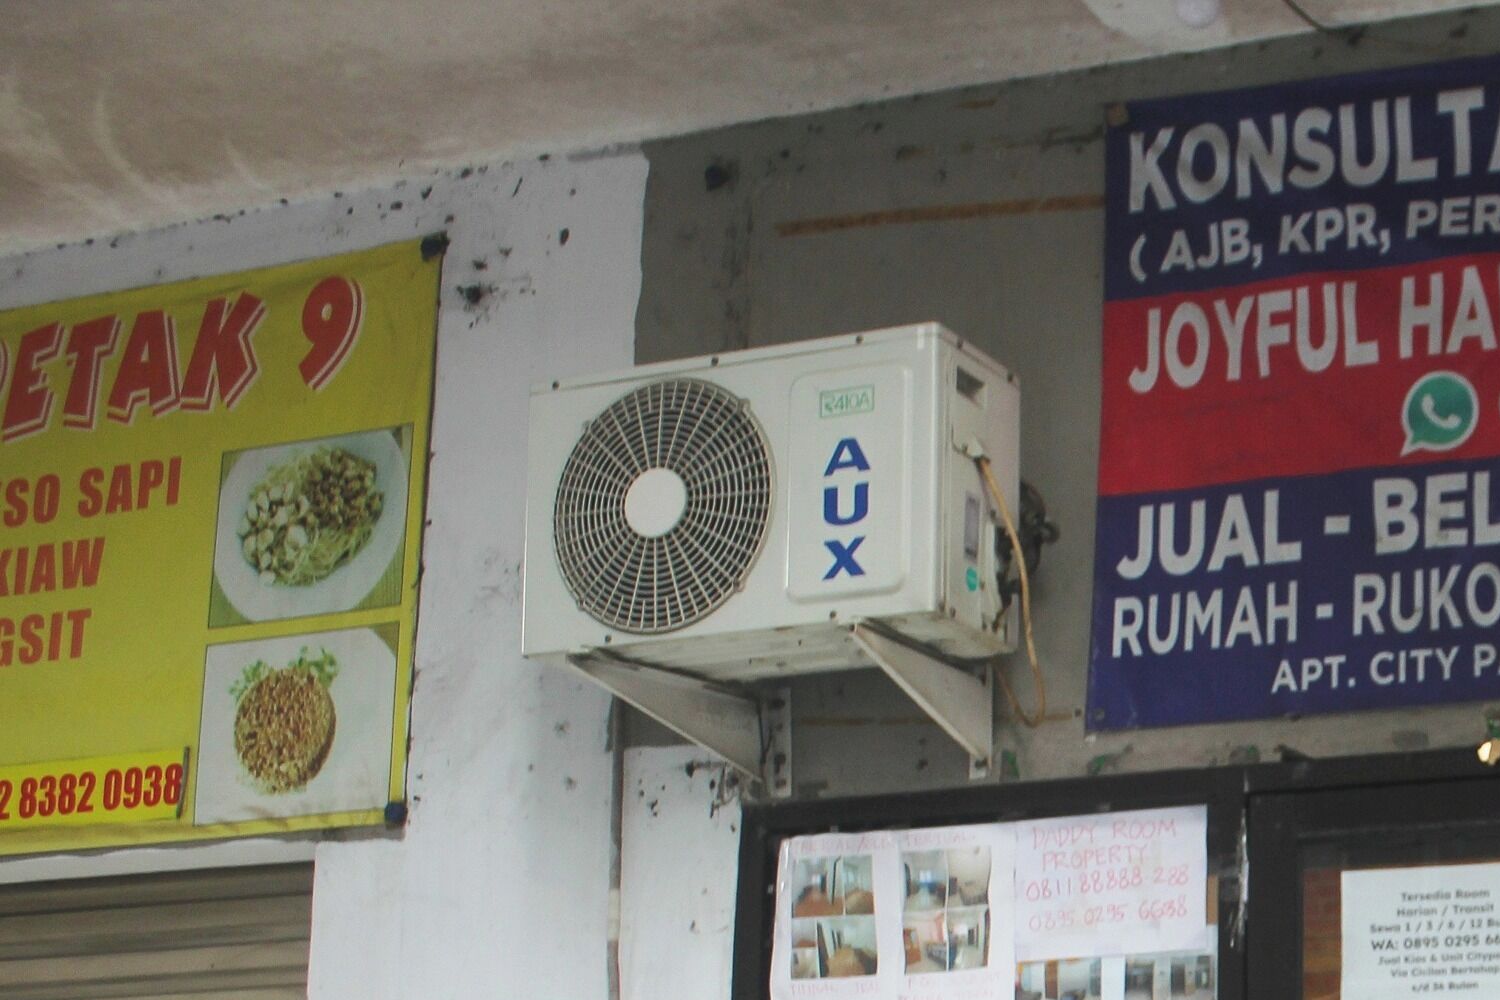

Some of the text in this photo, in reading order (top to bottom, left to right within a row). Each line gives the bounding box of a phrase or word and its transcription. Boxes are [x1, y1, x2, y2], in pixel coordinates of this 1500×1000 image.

[1160, 218, 1263, 270] AJB,
[1279, 203, 1392, 254] KPR,
[0, 275, 364, 442] ETAK 9
[1129, 282, 1379, 393] JOYFUL
[0, 455, 182, 528] SO SAPI
[823, 436, 871, 581] AUX
[1116, 490, 1302, 580] JUAL
[1112, 580, 1298, 658] RUMAH
[1271, 656, 1356, 694] APT.
[1370, 646, 1459, 685] CITY
[19, 771, 96, 819] 8382
[103, 763, 184, 811] 0938
[1042, 843, 1148, 872] PROPERTY
[1112, 818, 1176, 840] ROOM
[1456, 888, 1490, 899] Room
[1403, 935, 1439, 950] 0895
[1444, 934, 1480, 948] 0295
